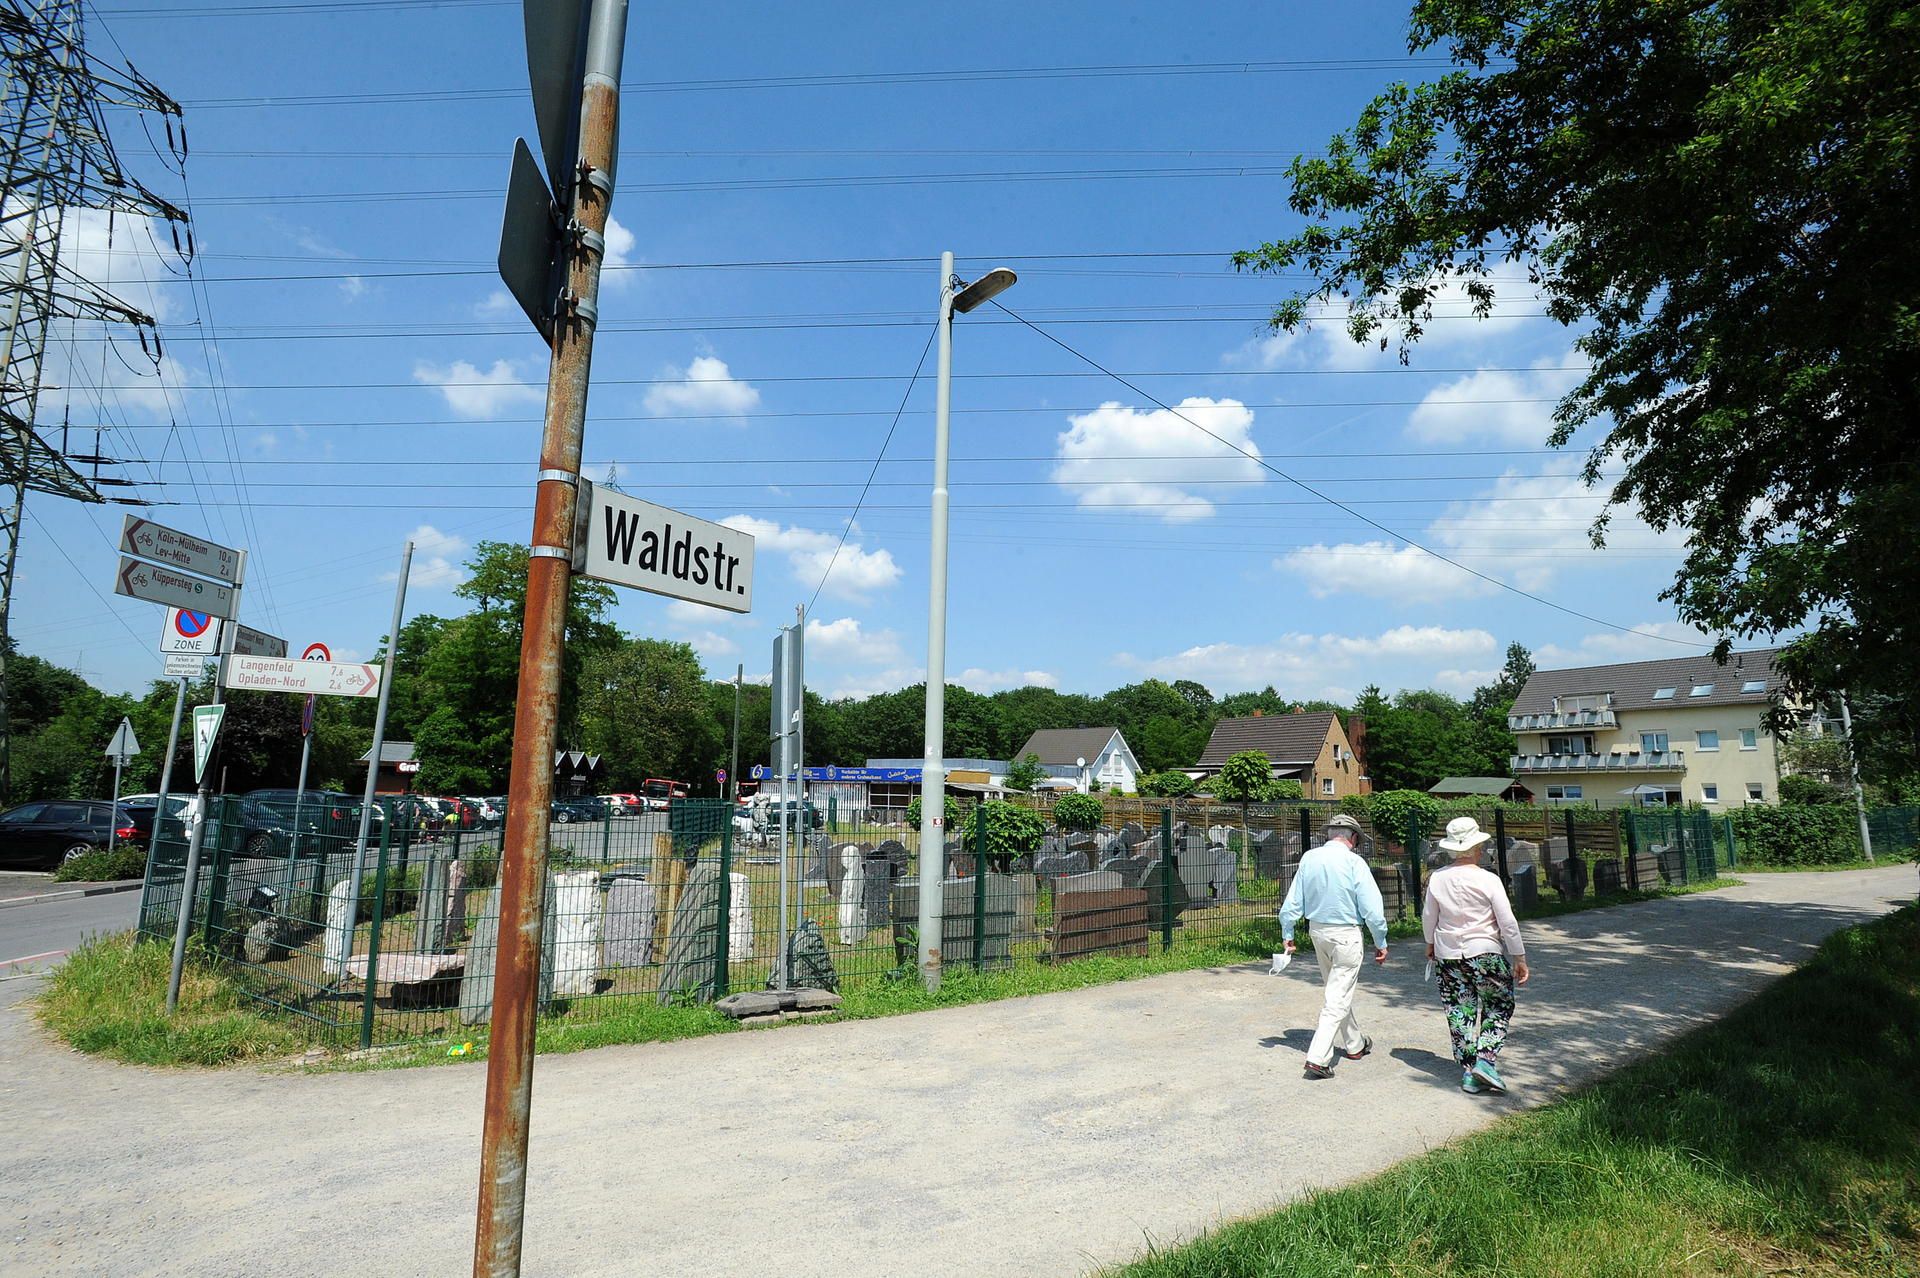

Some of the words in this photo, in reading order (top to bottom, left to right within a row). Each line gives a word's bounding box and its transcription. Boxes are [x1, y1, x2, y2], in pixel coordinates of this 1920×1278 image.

[157, 529, 208, 555] Köln-Mülheim
[604, 504, 745, 596] Waldstr.
[155, 544, 191, 564] Lev-Mitte
[151, 568, 193, 593] Küppersteg
[174, 640, 202, 650] ZONE
[240, 658, 294, 673] Langenfeld
[238, 672, 306, 688] Opladen-Nord
